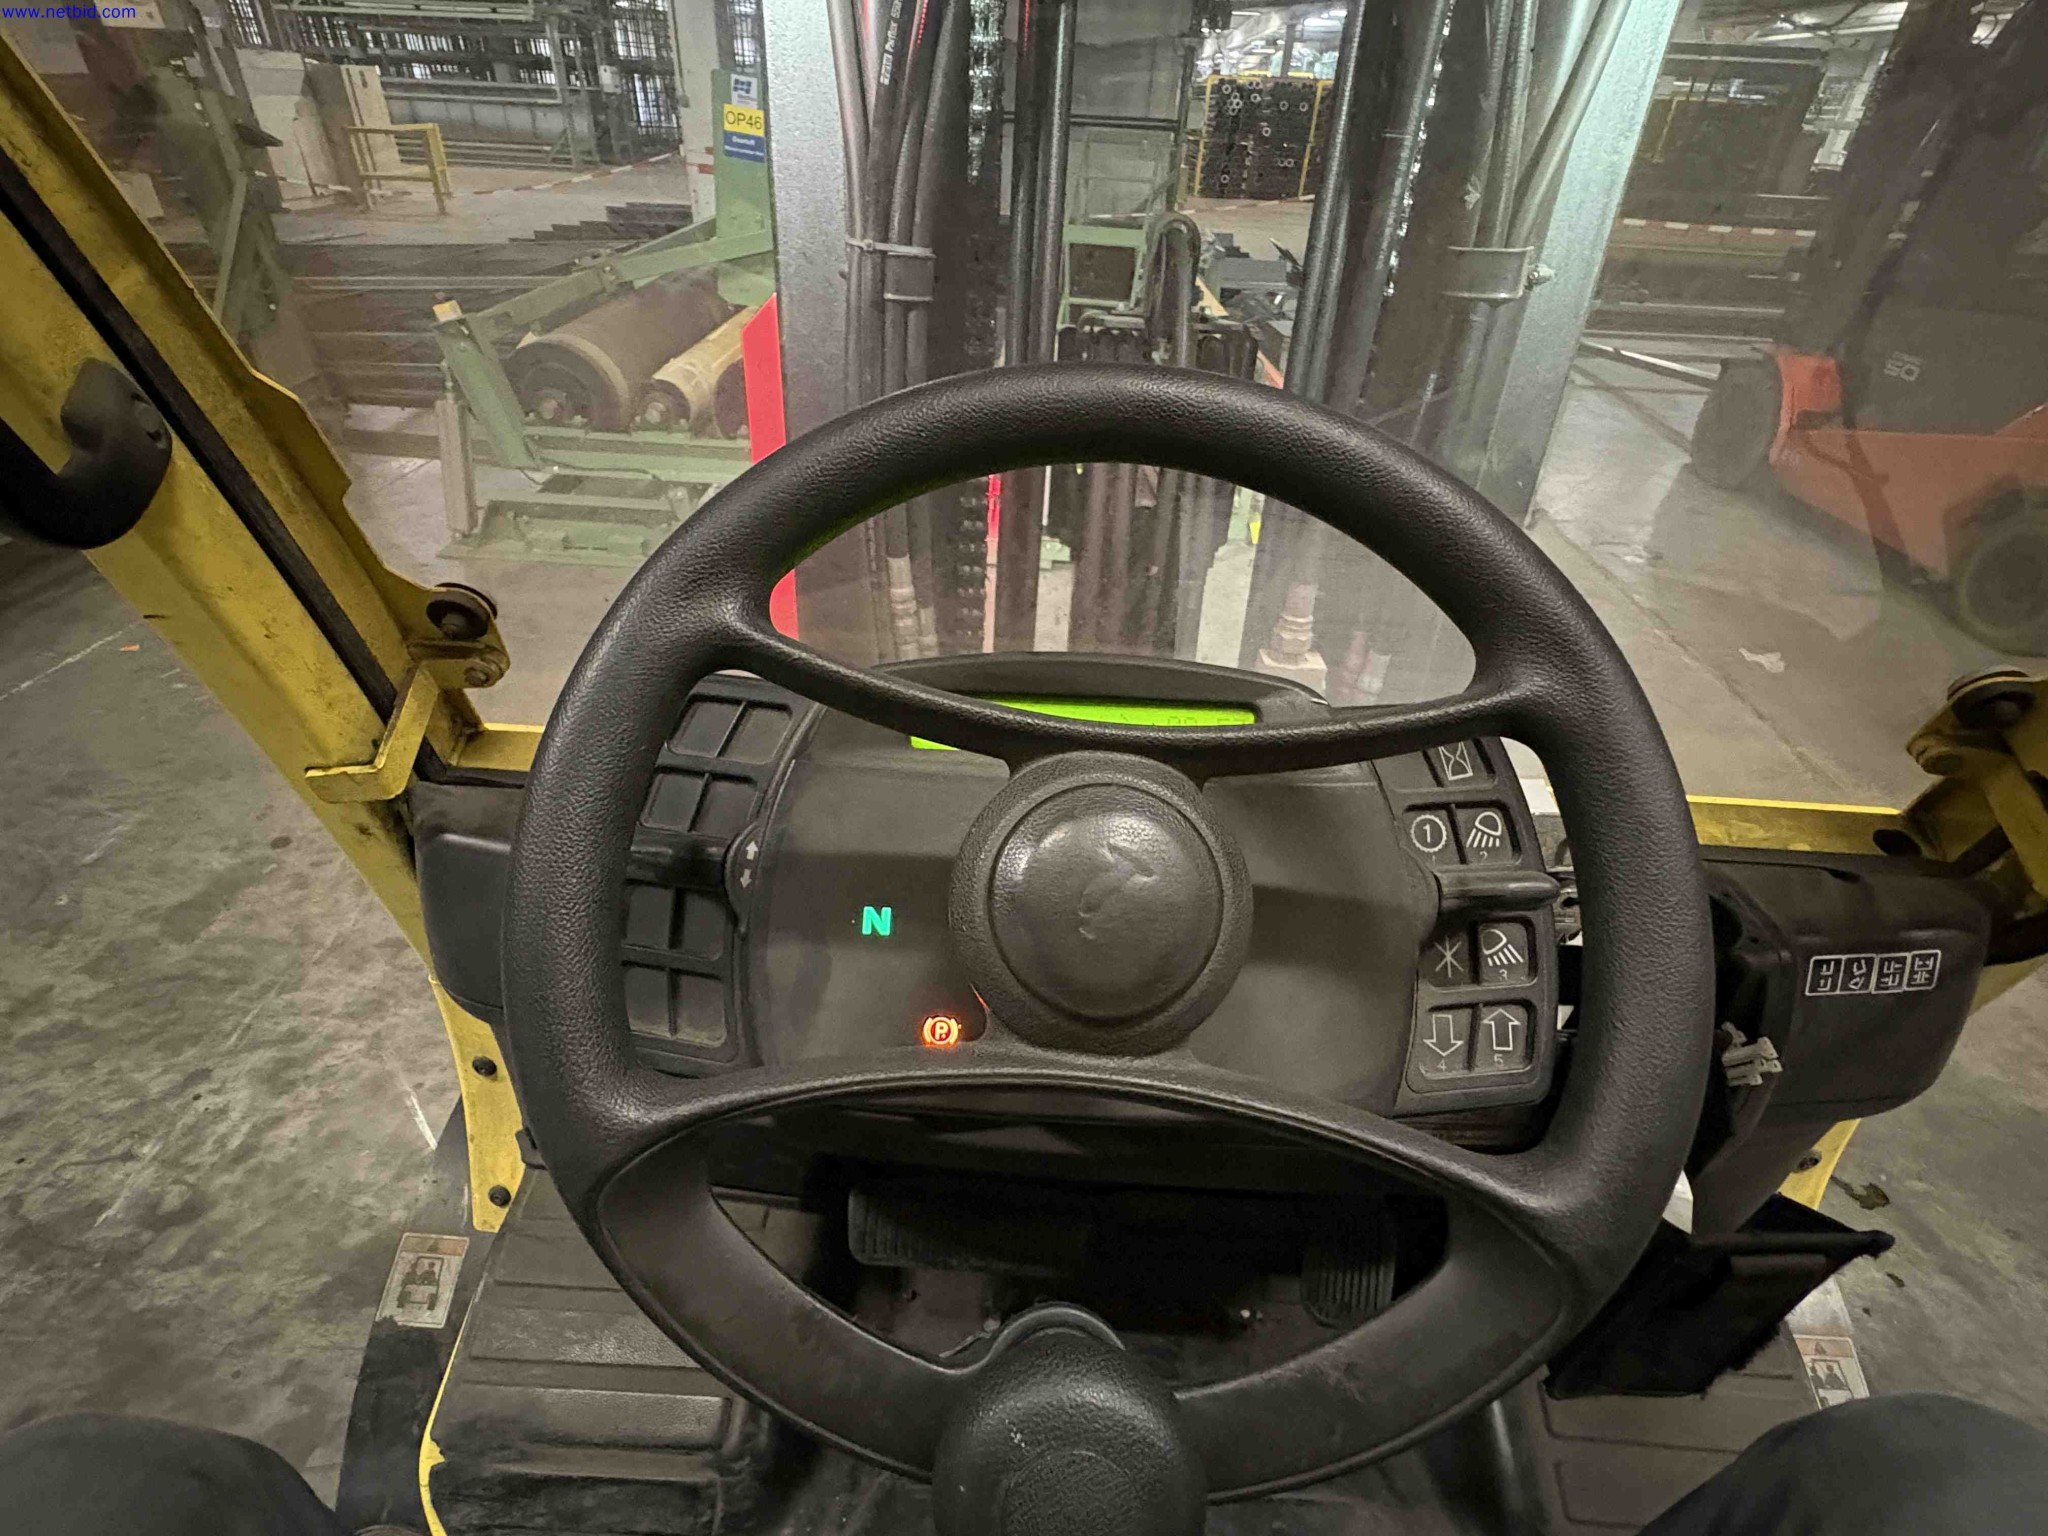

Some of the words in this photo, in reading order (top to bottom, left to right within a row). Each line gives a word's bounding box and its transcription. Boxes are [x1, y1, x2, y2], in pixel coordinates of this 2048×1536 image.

[725, 110, 763, 130] OP46
[1423, 823, 1431, 843] 1
[861, 905, 892, 936] N
[934, 1021, 949, 1041] P
[1437, 1059, 1447, 1072] 4
[1493, 1053, 1504, 1070] 5
